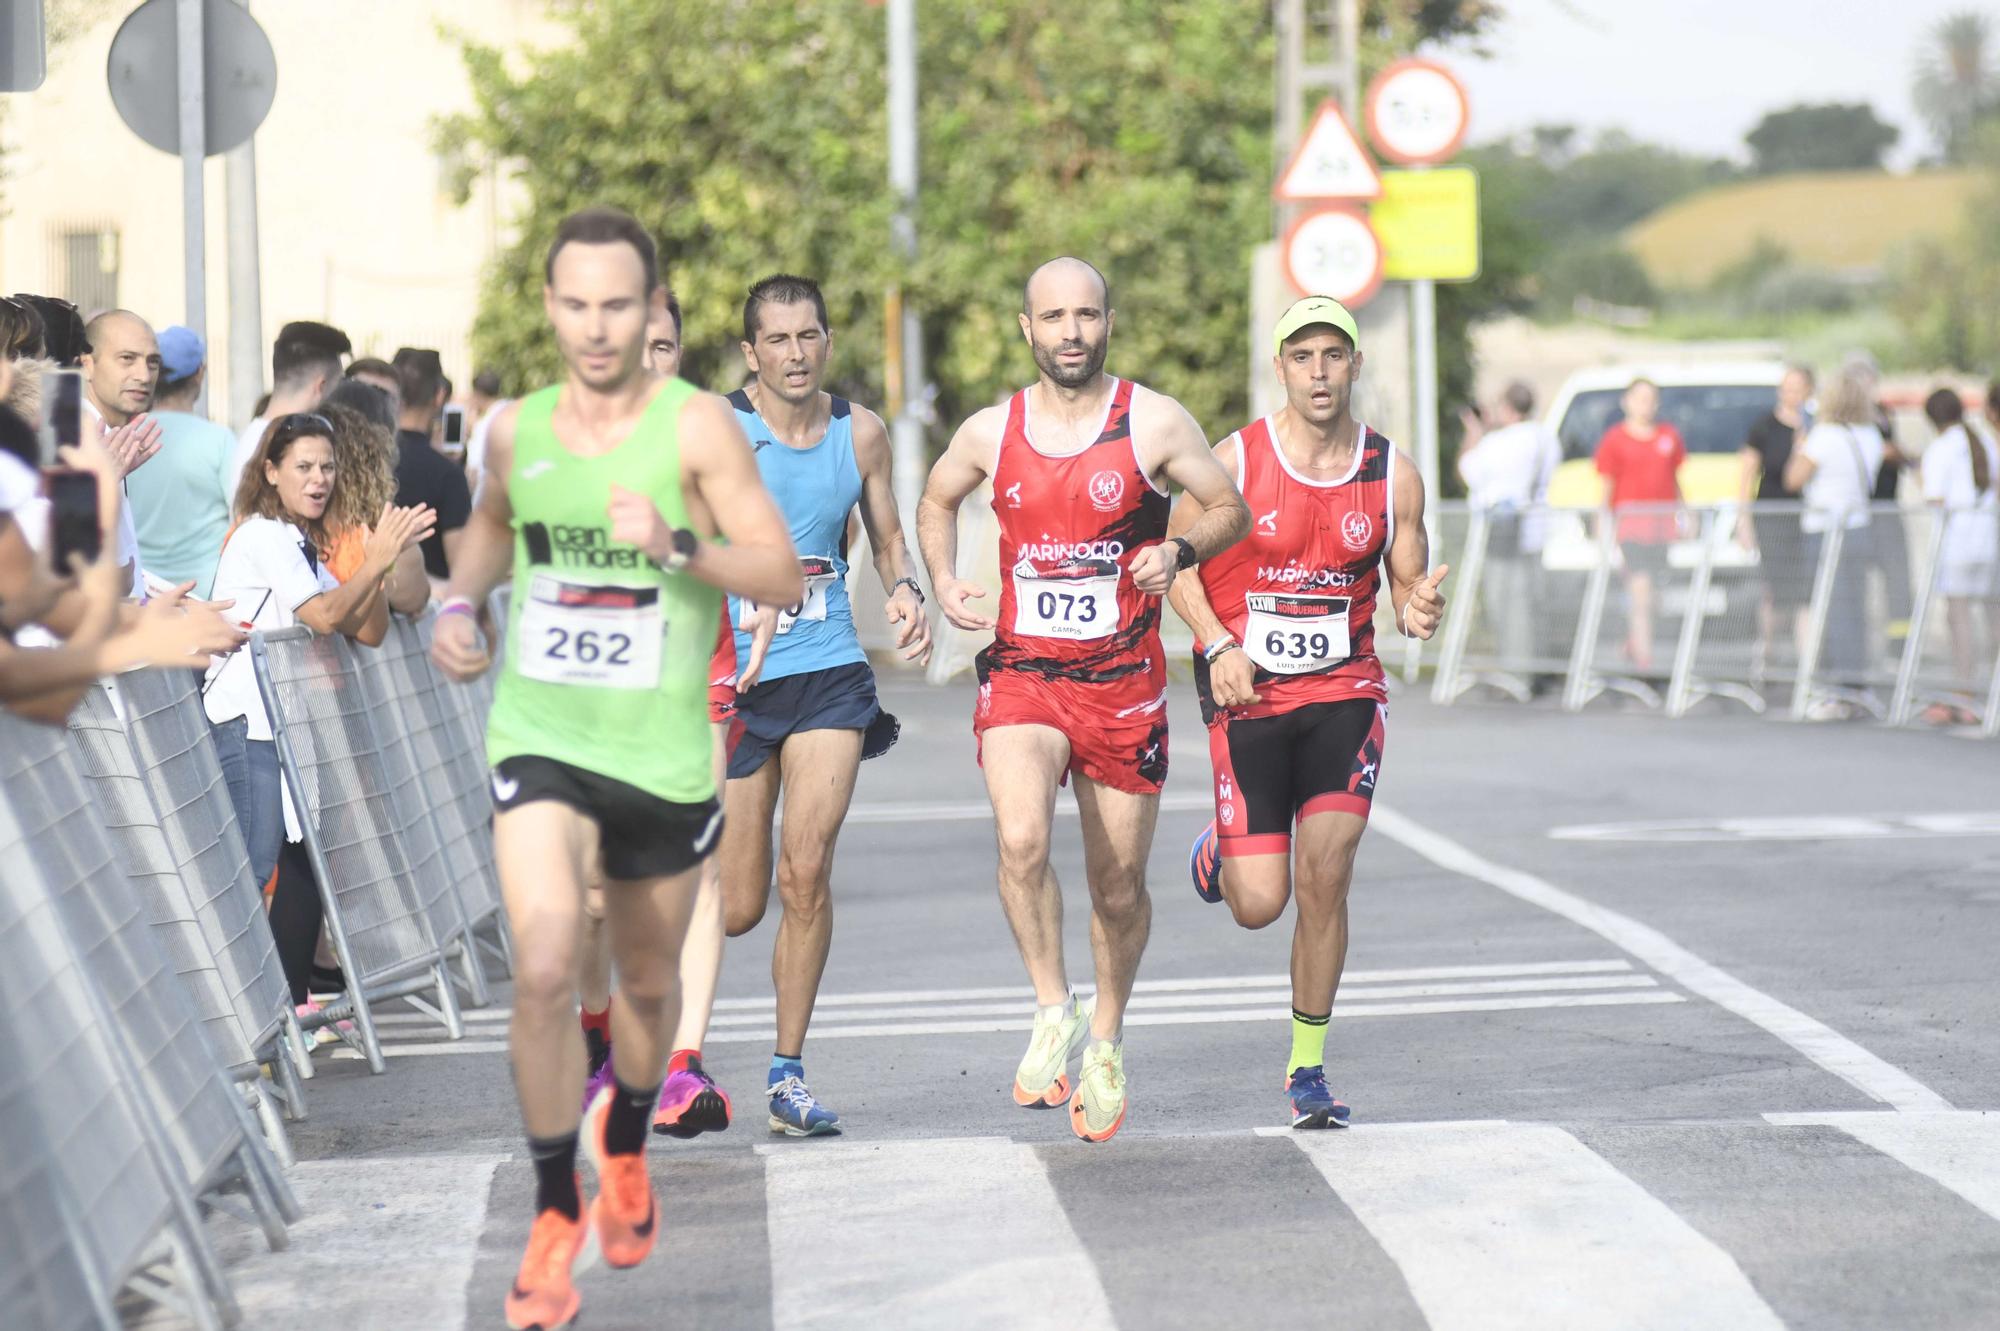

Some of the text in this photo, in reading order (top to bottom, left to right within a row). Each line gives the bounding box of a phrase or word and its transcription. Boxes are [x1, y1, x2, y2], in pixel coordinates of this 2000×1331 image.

[557, 547, 661, 570] moren
[1018, 541, 1124, 561] MARINOCIO
[1037, 591, 1097, 622] 073
[544, 627, 631, 665] 262
[1265, 630, 1329, 659] 639
[1220, 783, 1232, 800] M
